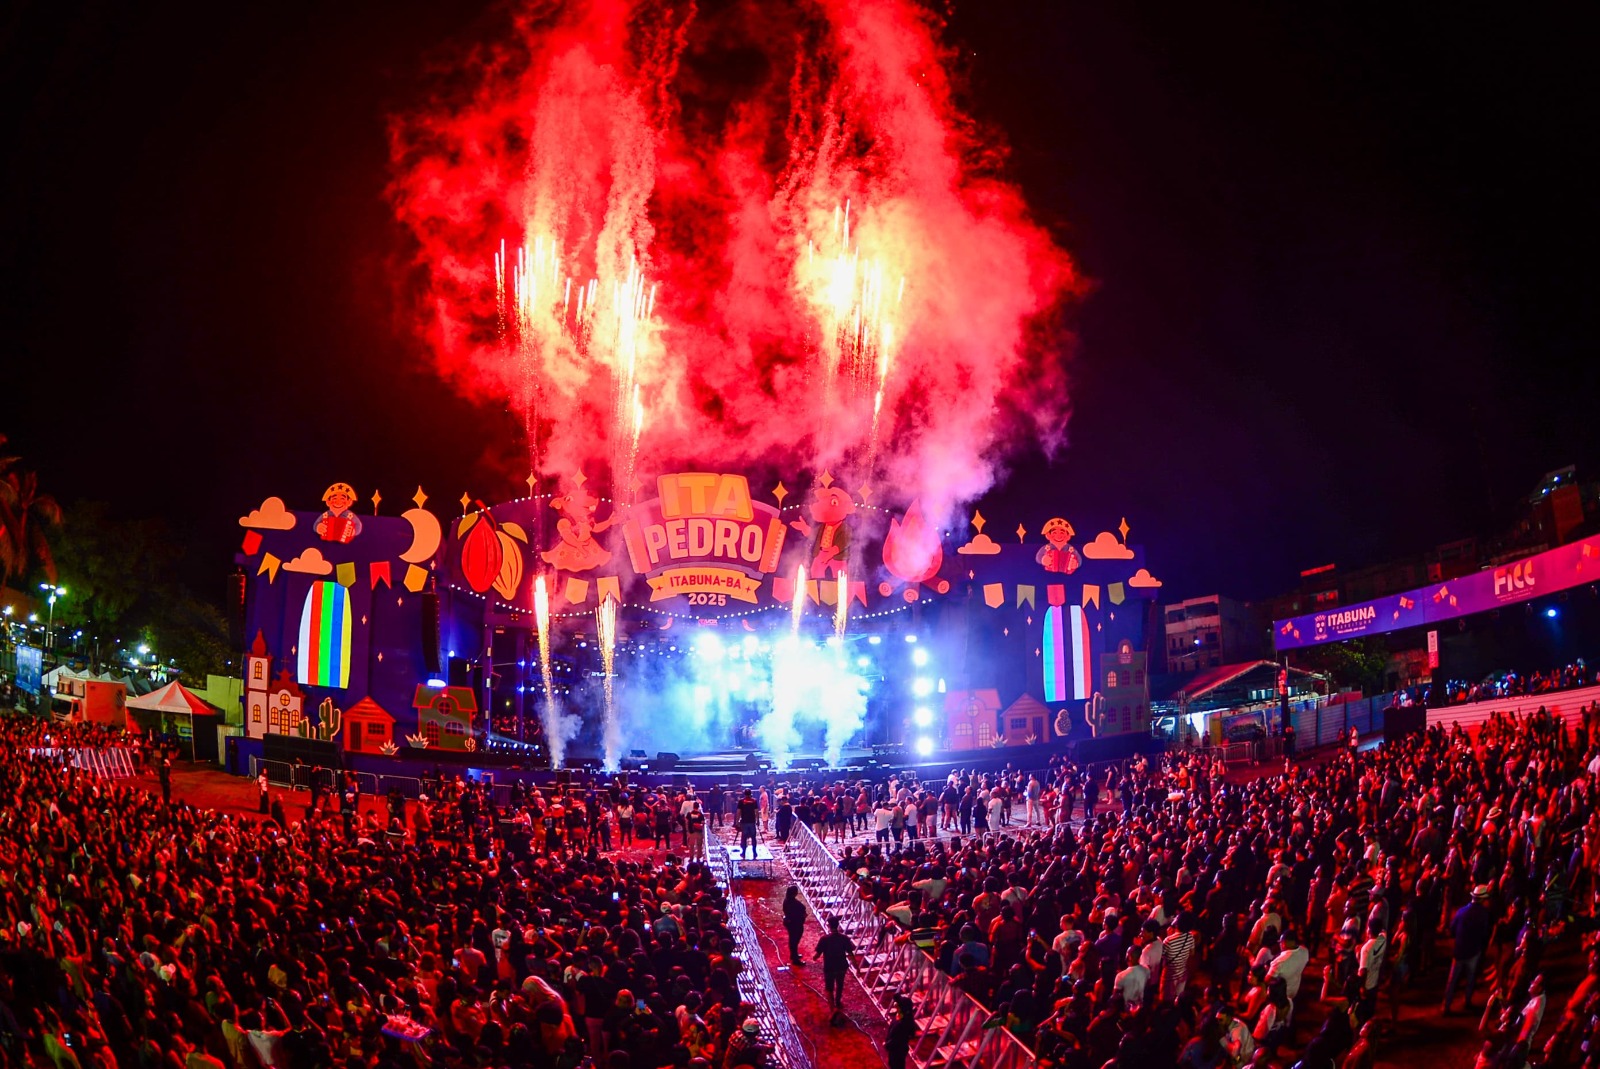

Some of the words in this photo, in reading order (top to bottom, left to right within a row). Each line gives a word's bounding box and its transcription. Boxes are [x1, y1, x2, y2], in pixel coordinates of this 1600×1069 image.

[660, 475, 750, 519] ITA
[643, 518, 763, 564] PEDRO
[669, 574, 742, 589] ITABUNA-BA
[688, 592, 727, 607] 2025
[1327, 605, 1376, 627] ITABUNA
